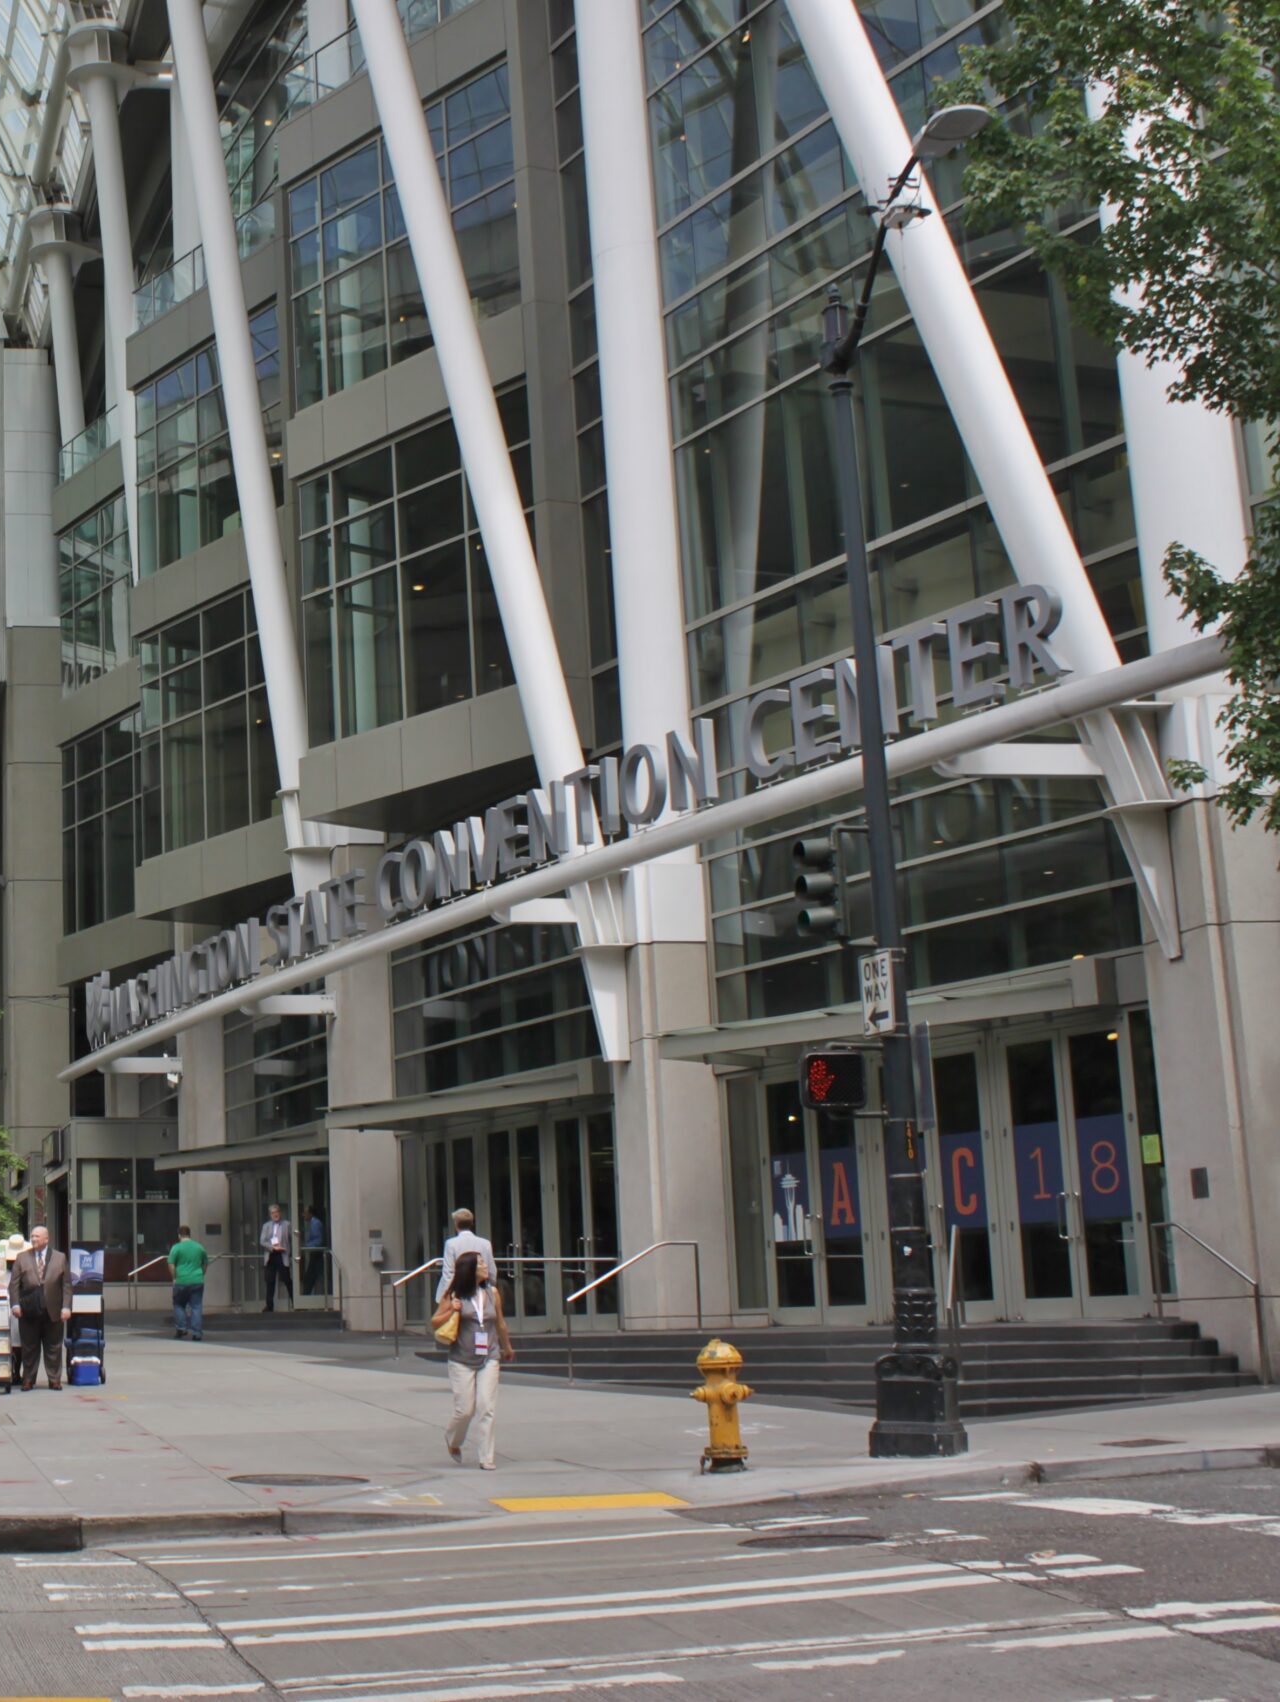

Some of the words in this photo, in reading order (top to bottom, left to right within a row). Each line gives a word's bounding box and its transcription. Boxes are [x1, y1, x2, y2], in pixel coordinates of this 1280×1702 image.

[85, 916, 261, 1050] WASHINGTON
[261, 867, 368, 968] STATE
[375, 715, 720, 921] CONVENTION
[747, 583, 1075, 779] CENTER
[863, 958, 888, 981] ONE
[864, 981, 889, 1003] WAY
